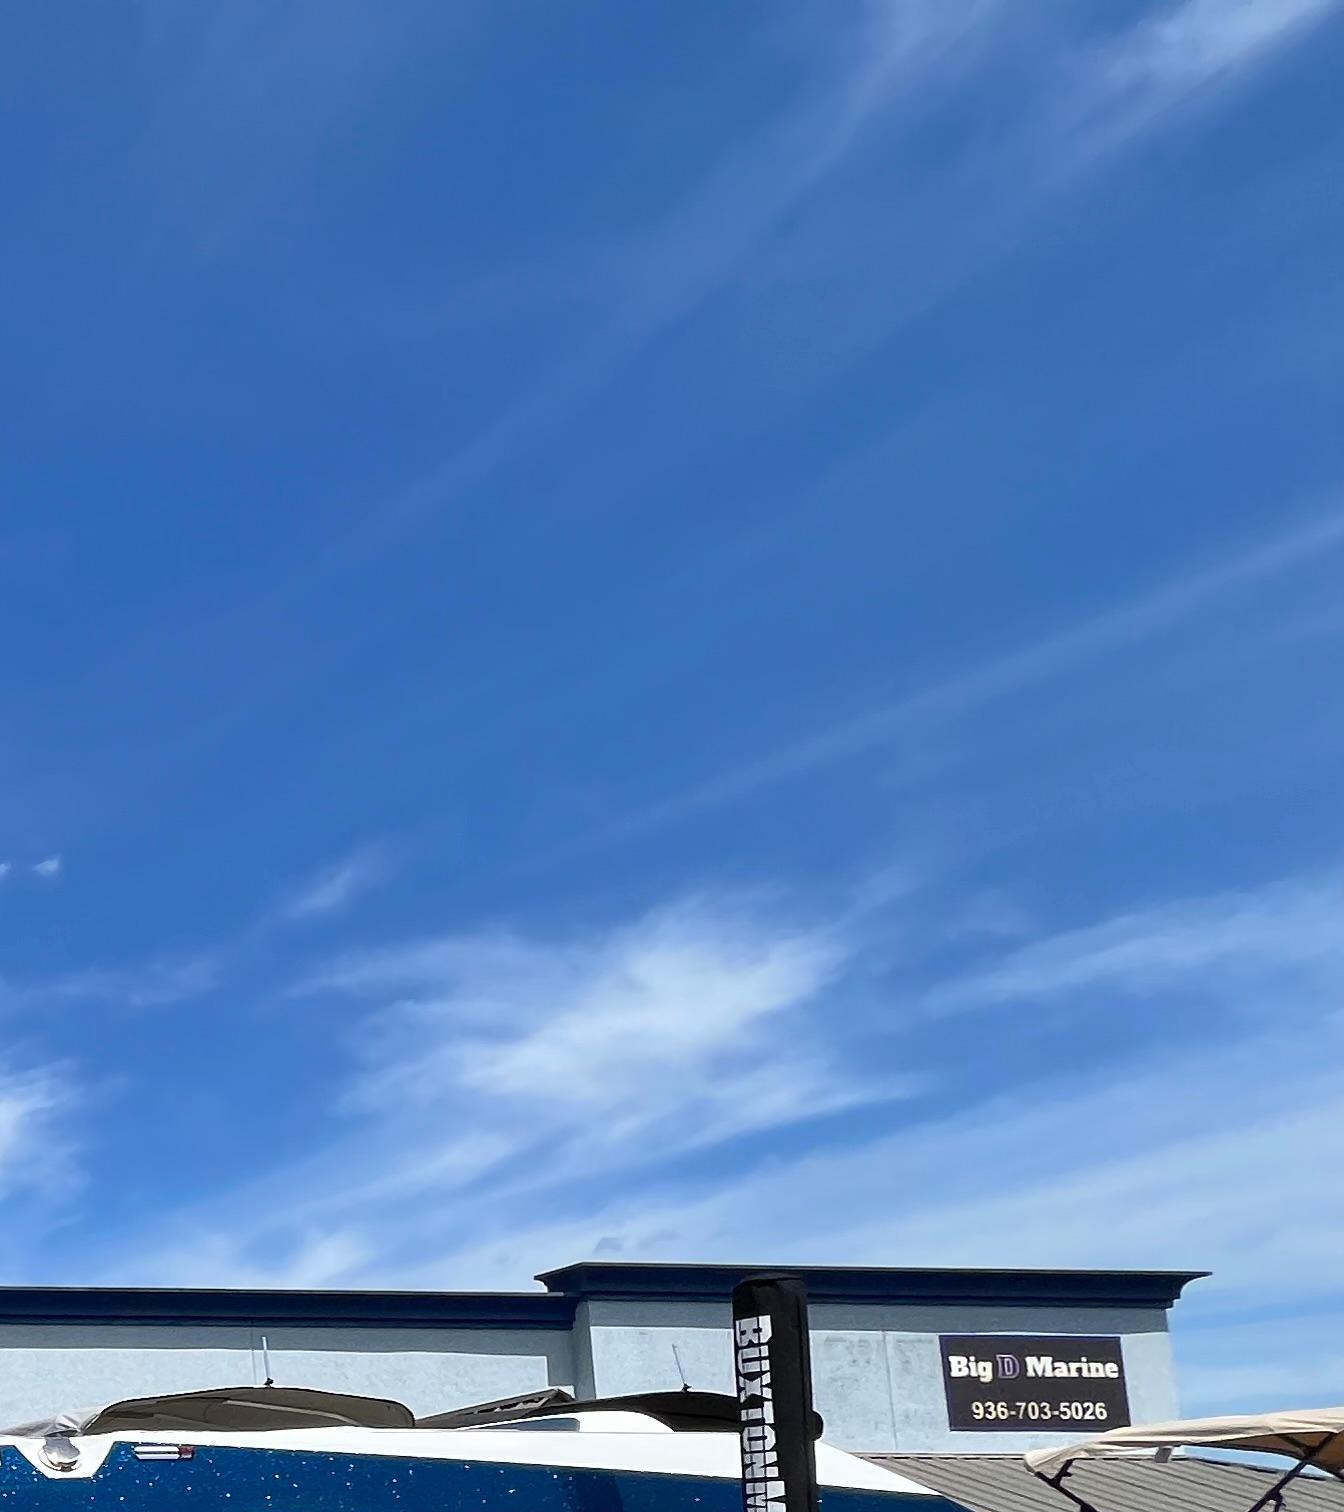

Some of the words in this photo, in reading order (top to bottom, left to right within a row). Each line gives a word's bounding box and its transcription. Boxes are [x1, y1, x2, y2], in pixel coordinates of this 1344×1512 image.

[948, 1355, 993, 1382] Big
[996, 1354, 1020, 1379] D
[1025, 1356, 1119, 1379] Marine
[971, 1401, 1108, 1421] 936-703-5026
